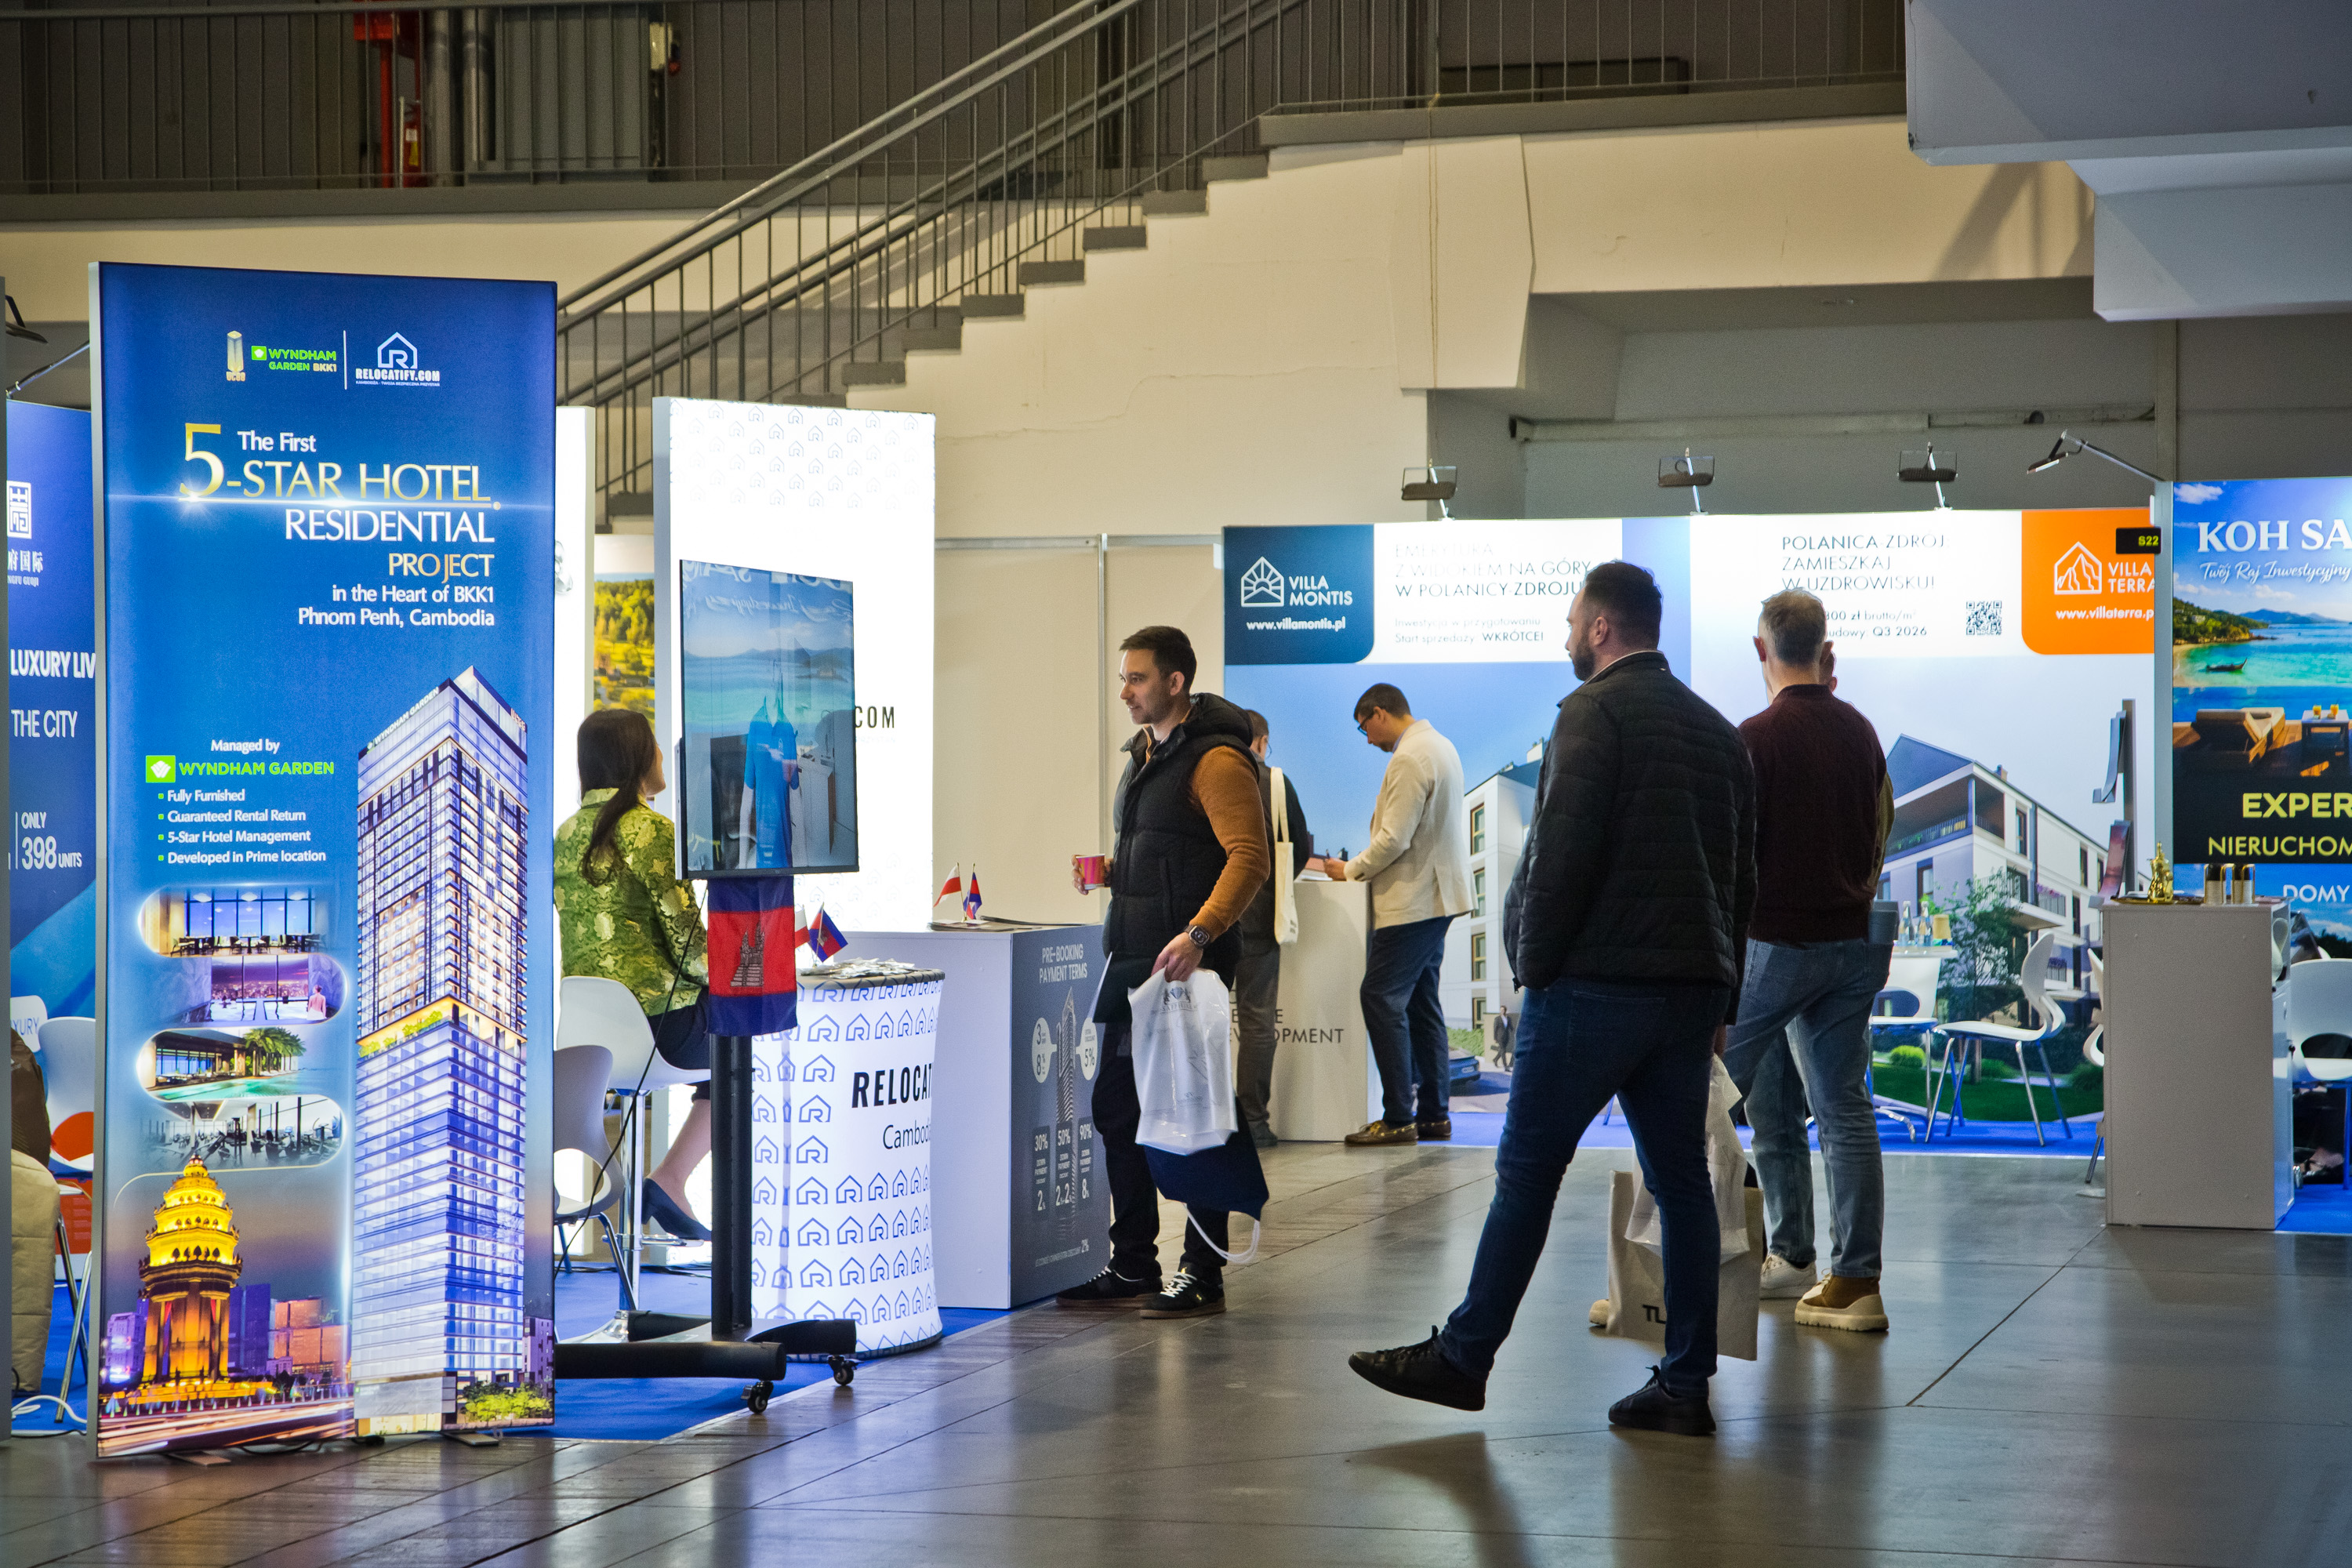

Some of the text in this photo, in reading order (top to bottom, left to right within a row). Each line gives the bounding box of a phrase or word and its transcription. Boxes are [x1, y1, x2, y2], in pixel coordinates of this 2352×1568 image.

[268, 348, 336, 361] WYNDHAM
[268, 361, 337, 372] GARDEN BKK1
[355, 368, 440, 382] RELOCATIFY.COM
[237, 430, 317, 452] The First
[360, 463, 491, 501] HOTEL
[285, 508, 495, 543] RESIDENTIAL
[2138, 535, 2159, 546] S22
[2198, 519, 2352, 552] KOH SA
[388, 553, 495, 583] PROJECT
[1396, 557, 1591, 578] Z WIDOKIEM NA GÓRY
[1782, 555, 1891, 572] ZAMIESZKAJ
[2107, 561, 2152, 576] VILLA
[2200, 560, 2352, 585] Twój Raj Inwestycyjny
[1288, 575, 1329, 590] VILLA
[1395, 584, 1413, 597] W
[1781, 575, 1935, 591] W UZDROWISKU!
[332, 584, 495, 603] in the Heart of BKK1
[1289, 590, 1353, 606] MONTIS
[299, 607, 495, 628] Phnom Penh, Cambodia
[1246, 615, 1346, 632] www.villamontis.pl
[1395, 618, 1448, 630] Inwestycja
[1463, 617, 1541, 629] przygotowaniu
[1851, 610, 1860, 620] zł
[1395, 633, 1419, 644] Start
[1482, 629, 1544, 642] WKRÓTCE!
[1872, 626, 1891, 637] Q3
[1896, 626, 1927, 637] 2026
[10, 648, 71, 677] LUXURY
[11, 710, 78, 738] THE CITY
[855, 705, 895, 729] COM
[211, 739, 280, 754] Managed by
[179, 761, 335, 775] WYNDHAM GARDEN
[168, 789, 245, 805] Fully Furnished
[2242, 793, 2352, 818] EXPER
[21, 811, 47, 829] ONLY
[168, 809, 307, 823] Guaranteed Rental Return
[168, 830, 311, 844] 5-Star Hotel Management
[21, 836, 82, 870] 398 UNITS
[168, 850, 326, 866] Developed in Prime location
[2282, 884, 2350, 902] DOMY
[1042, 944, 1083, 964] PRE-BOOKING
[1040, 963, 1087, 984] PAYMENT TERMS
[1036, 1023, 1042, 1045] 3
[1036, 1054, 1041, 1076] 8
[1084, 1046, 1095, 1067] 5%
[1057, 1128, 1071, 1146] 50%
[1079, 1123, 1092, 1141] 90%
[1034, 1133, 1048, 1152] 30%
